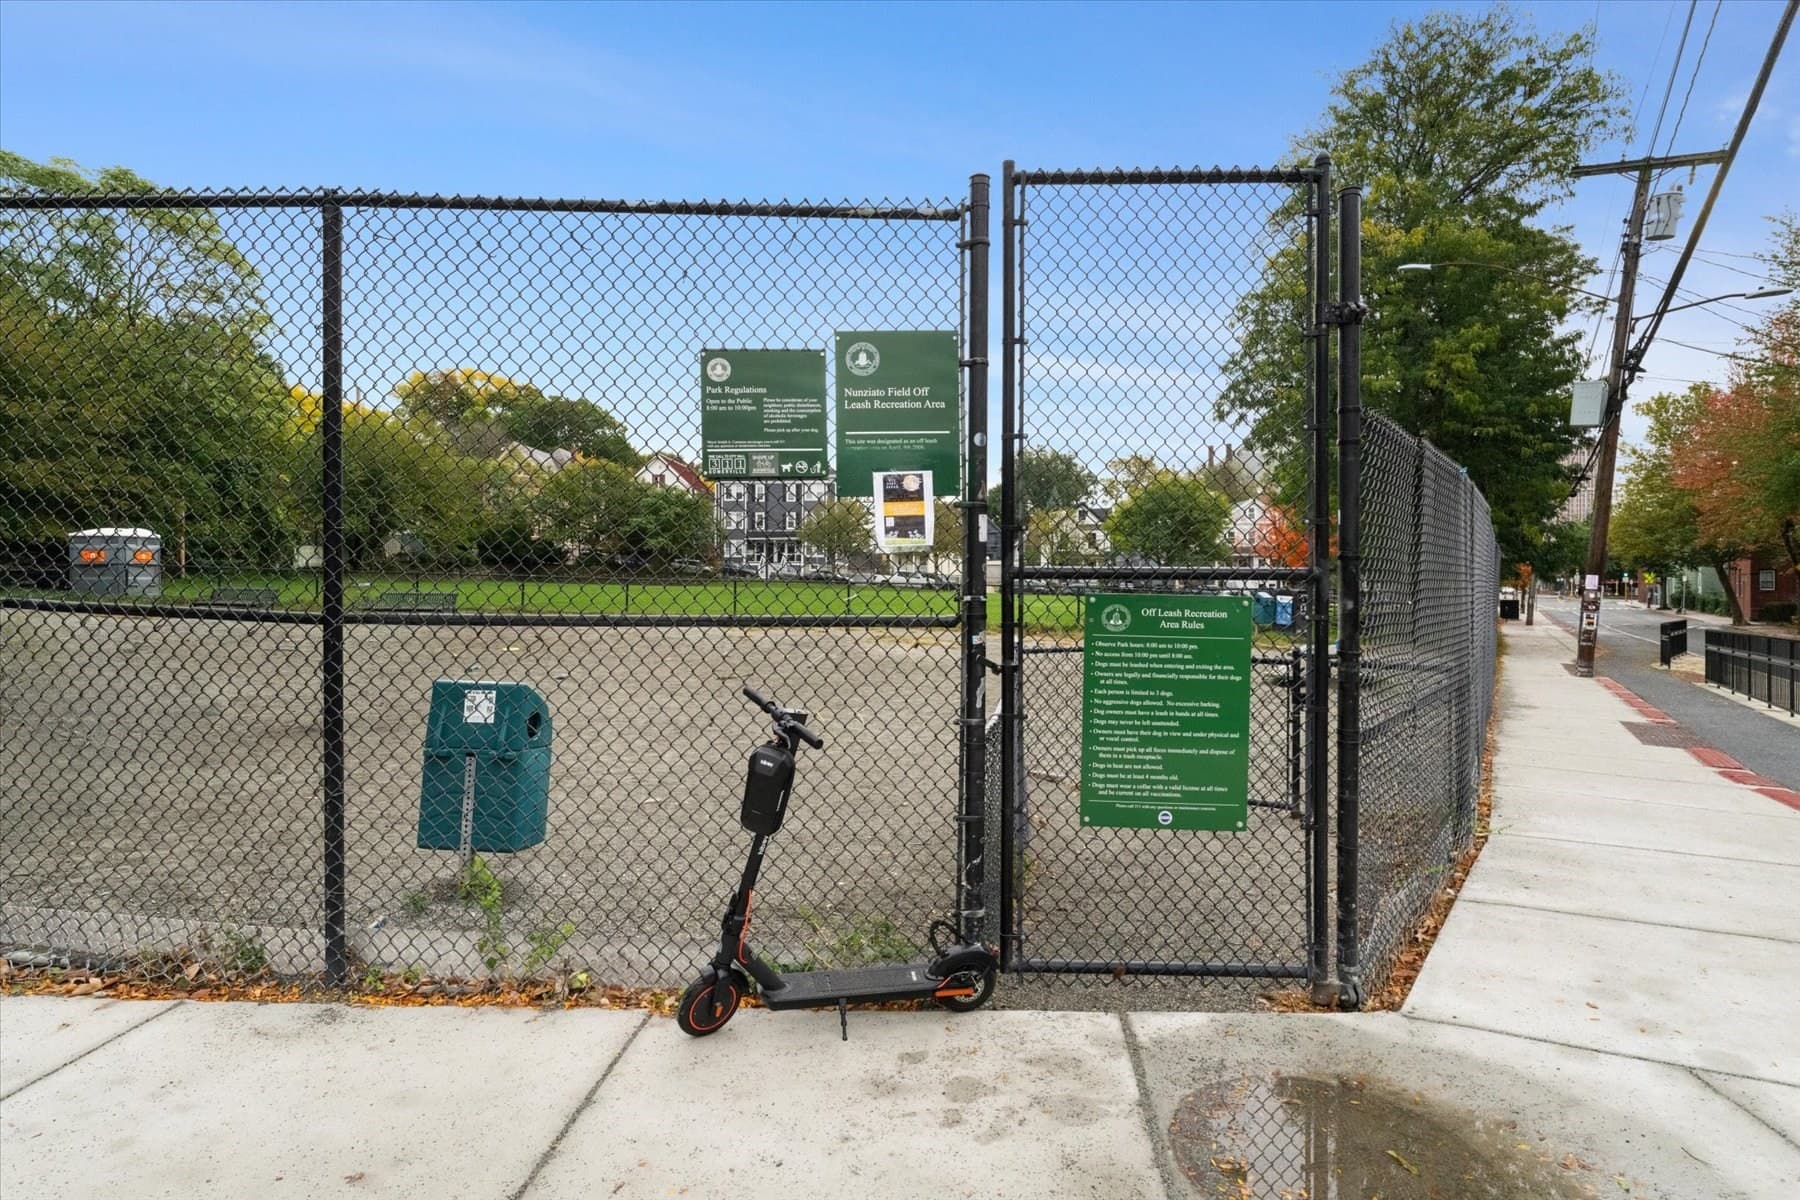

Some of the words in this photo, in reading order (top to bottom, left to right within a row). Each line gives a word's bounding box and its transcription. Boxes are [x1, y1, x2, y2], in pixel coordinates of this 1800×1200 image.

[724, 386, 767, 395] Regulations
[844, 388, 885, 397] Nunziato
[888, 387, 911, 396] Field
[912, 387, 930, 396] Off
[844, 400, 871, 409] Leash
[874, 400, 922, 409] Recreation
[923, 399, 946, 408] Area
[1141, 608, 1156, 616] Off
[1157, 608, 1182, 616] Leash
[1184, 609, 1227, 618] Recreation
[1160, 620, 1179, 628] Area
[1181, 620, 1204, 628] Rules
